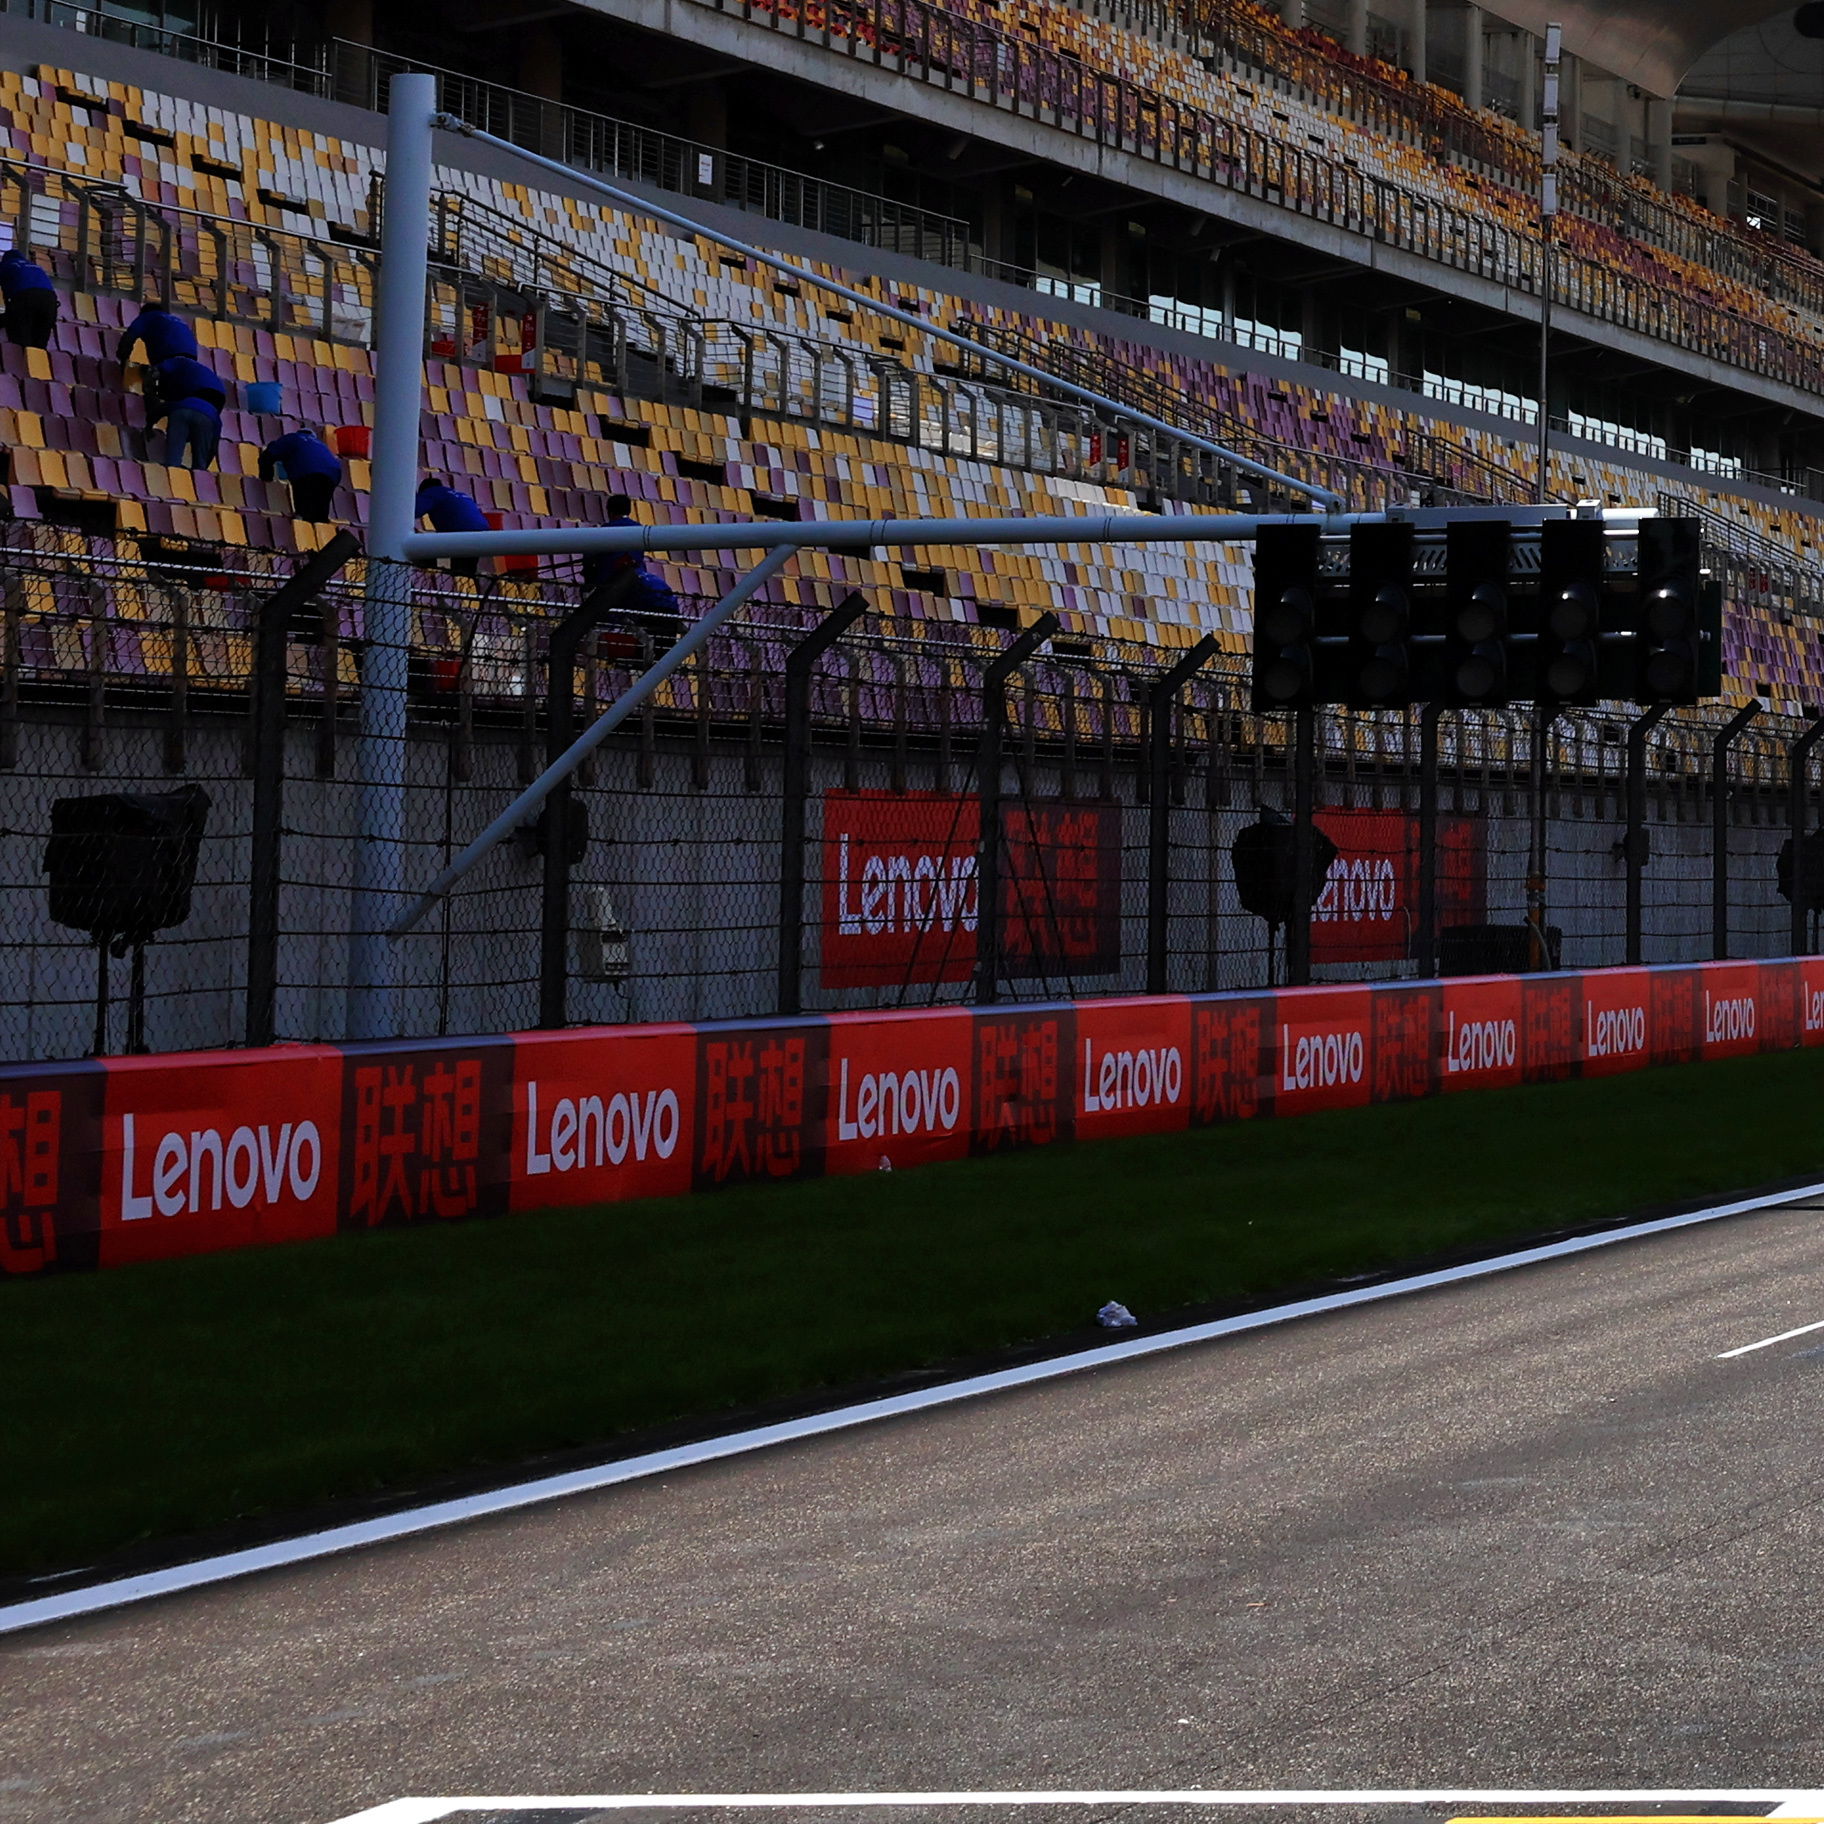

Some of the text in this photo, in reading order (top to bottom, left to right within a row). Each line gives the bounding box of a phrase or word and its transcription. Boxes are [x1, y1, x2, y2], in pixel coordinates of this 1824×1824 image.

[1283, 1023, 1364, 1091] Lenovo
[1447, 1010, 1516, 1073] Lenovo
[1587, 999, 1645, 1057] Lenovo
[1705, 989, 1755, 1043] Lenovo
[703, 1038, 806, 1180] 联想
[838, 1057, 960, 1141] Lenovo
[979, 1021, 1059, 1145] 联想
[1084, 1037, 1182, 1113] Lenovo
[121, 1112, 321, 1221] Lenovo
[350, 1059, 484, 1228] 联想
[526, 1080, 680, 1175] Lenovo
